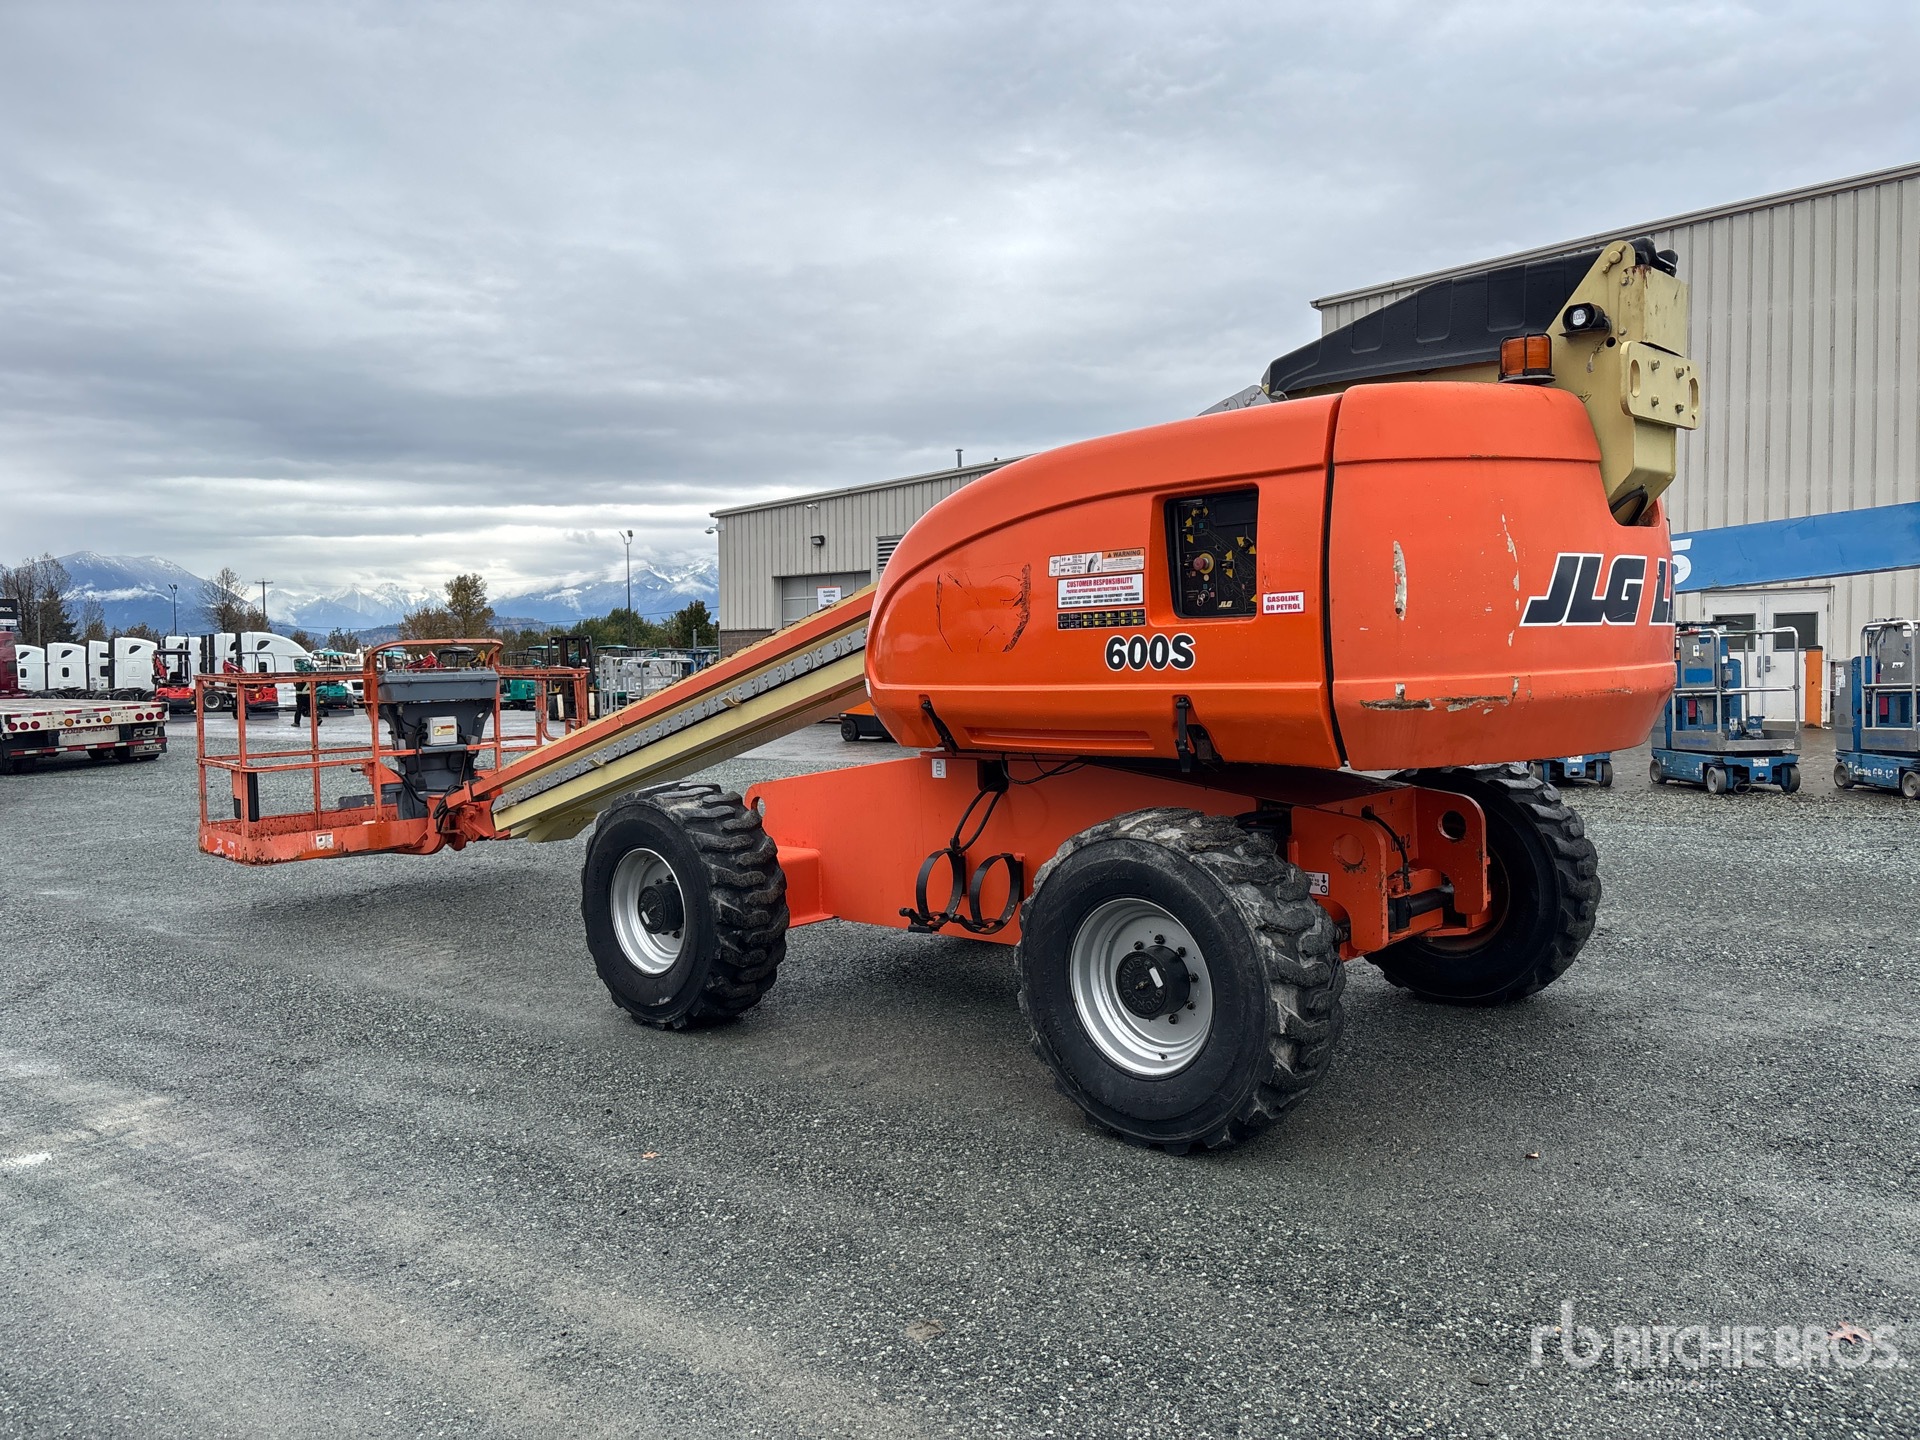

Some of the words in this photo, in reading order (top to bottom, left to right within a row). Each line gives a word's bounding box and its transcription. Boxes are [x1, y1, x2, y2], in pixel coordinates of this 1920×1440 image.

[1113, 550, 1141, 558] WARNING
[1067, 579, 1092, 588] CUSTOMER
[1093, 577, 1133, 586] RESPONSIBILITY
[1519, 552, 1648, 626] JLG
[1105, 633, 1196, 671] 600S
[133, 727, 158, 737] FGI
